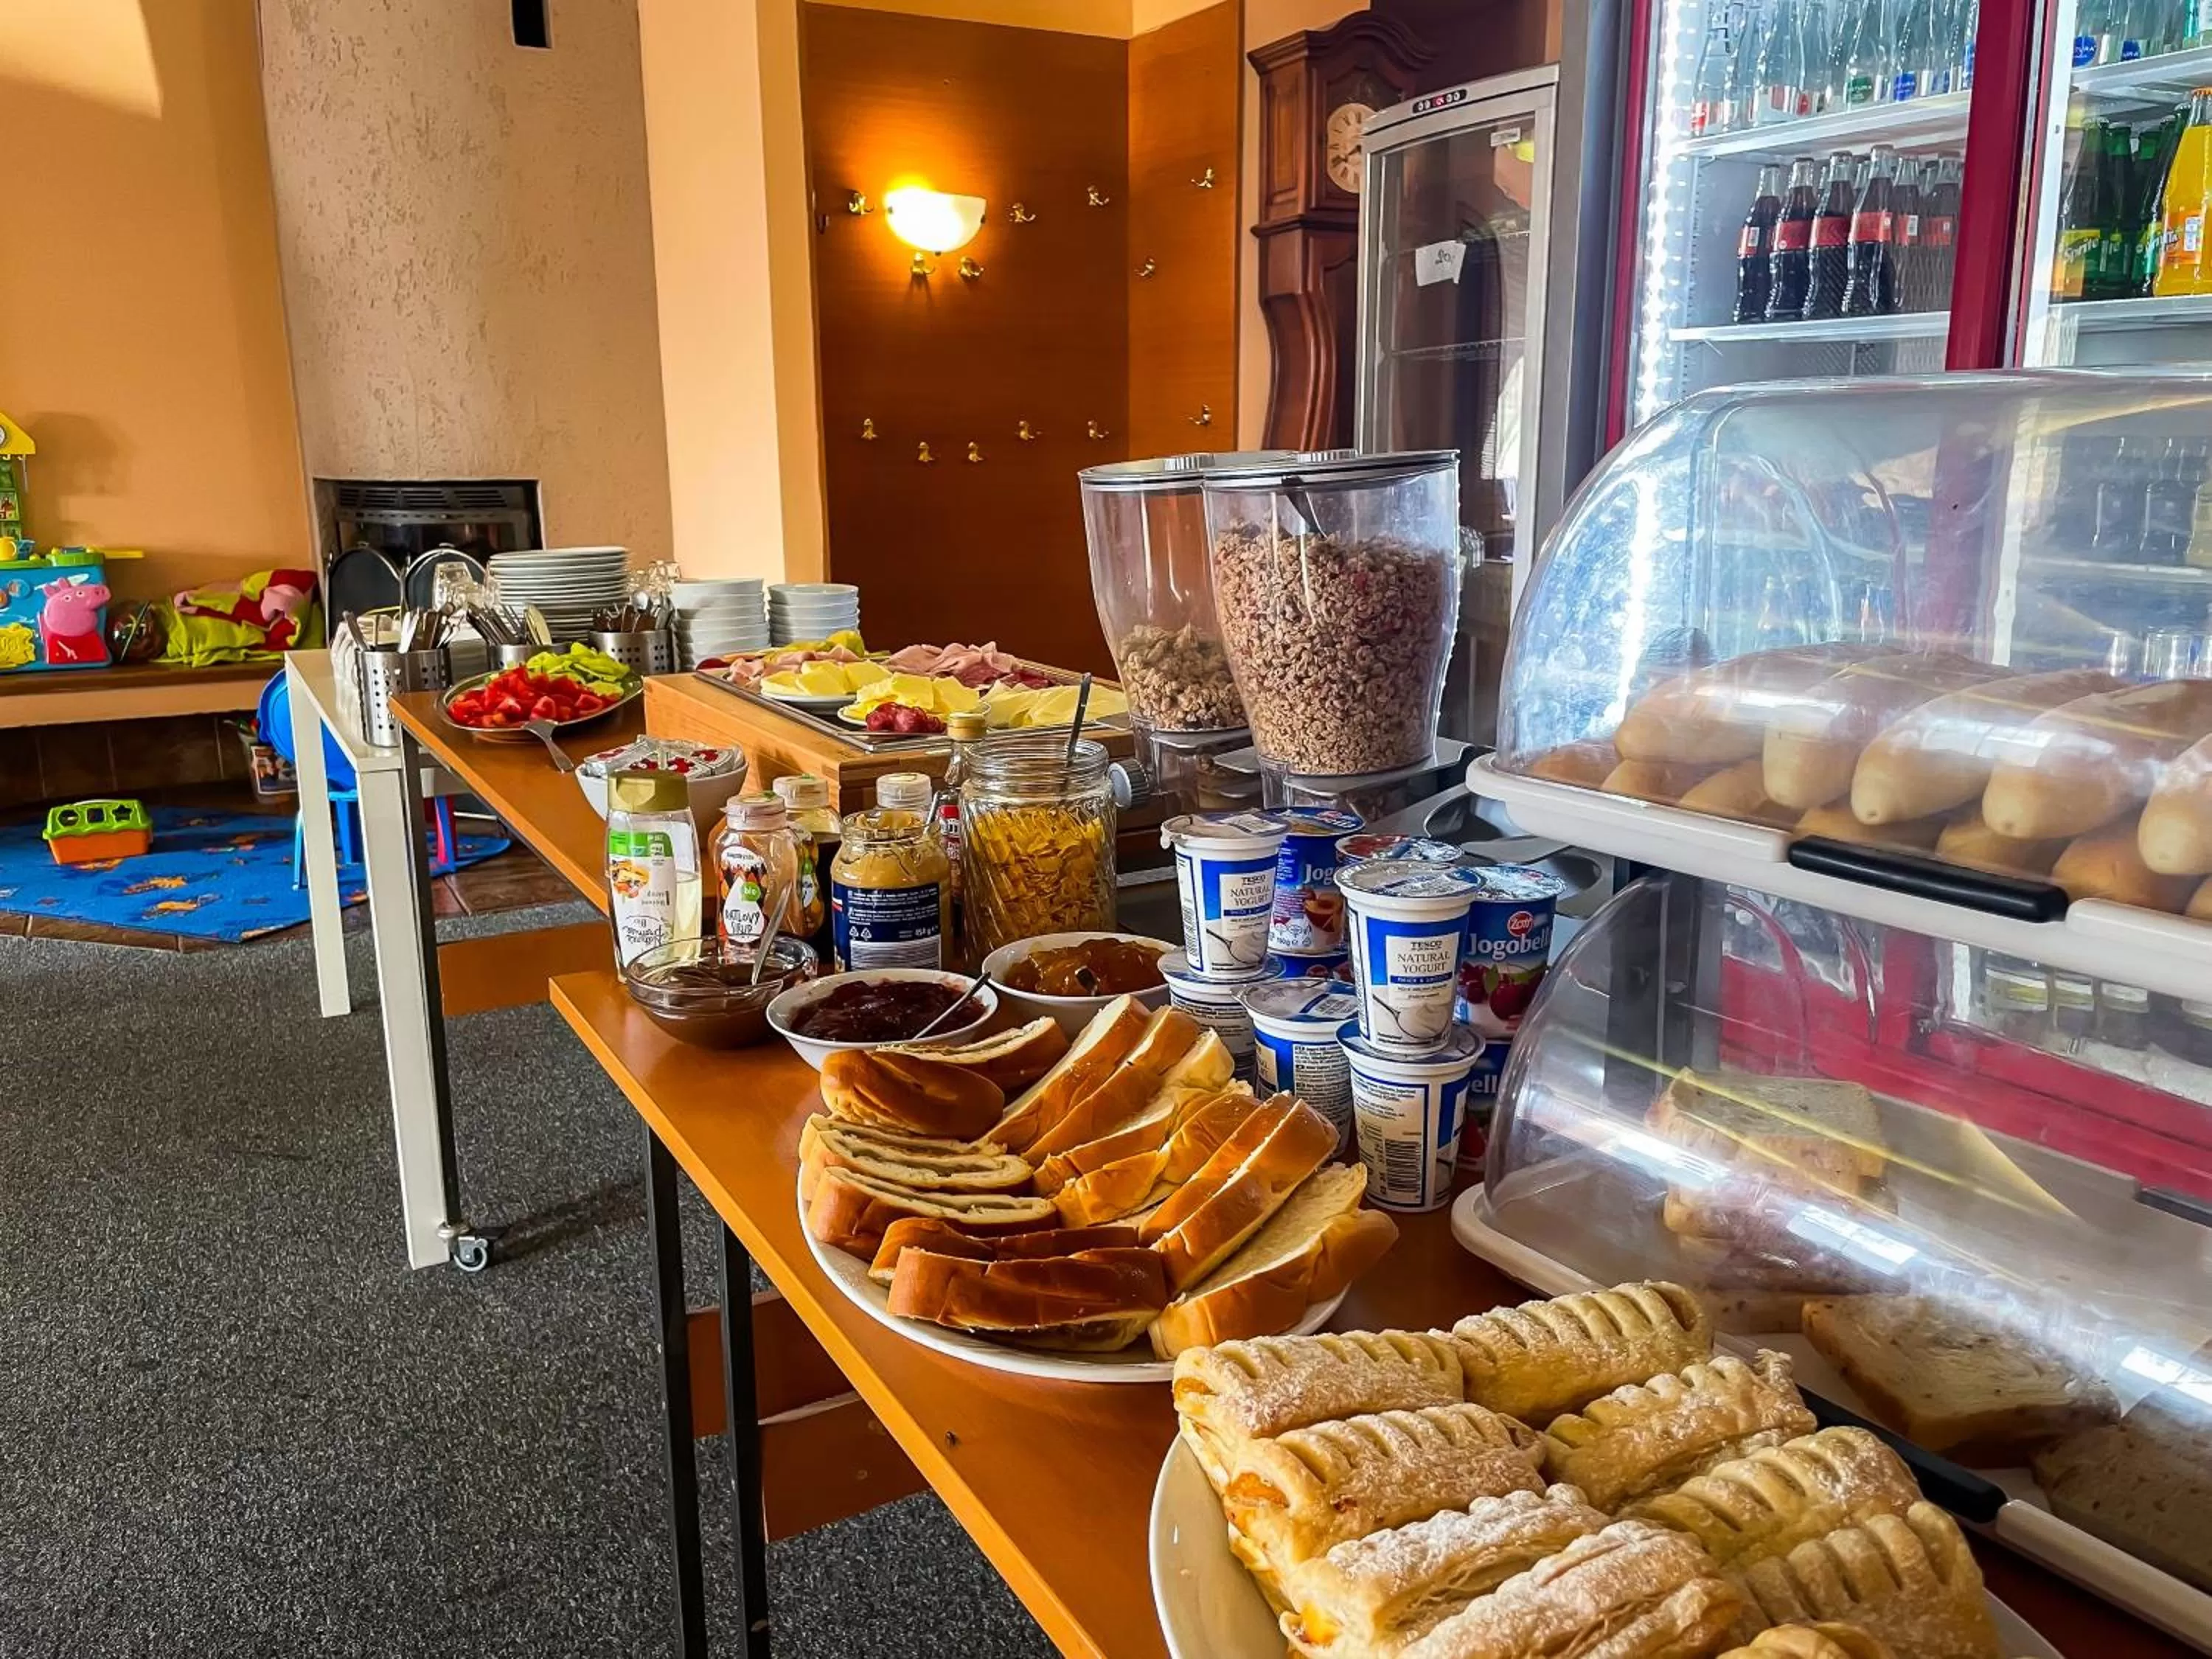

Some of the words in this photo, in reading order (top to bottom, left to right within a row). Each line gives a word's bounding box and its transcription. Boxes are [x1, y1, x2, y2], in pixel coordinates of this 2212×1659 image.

[1241, 874, 1266, 884] TESCO
[1230, 885, 1271, 897] NATURAL
[1234, 894, 1269, 906] YOGURT
[1411, 940, 1443, 950] TESCO
[1397, 951, 1451, 963] NATURAL
[1402, 961, 1447, 973] YOGURT
